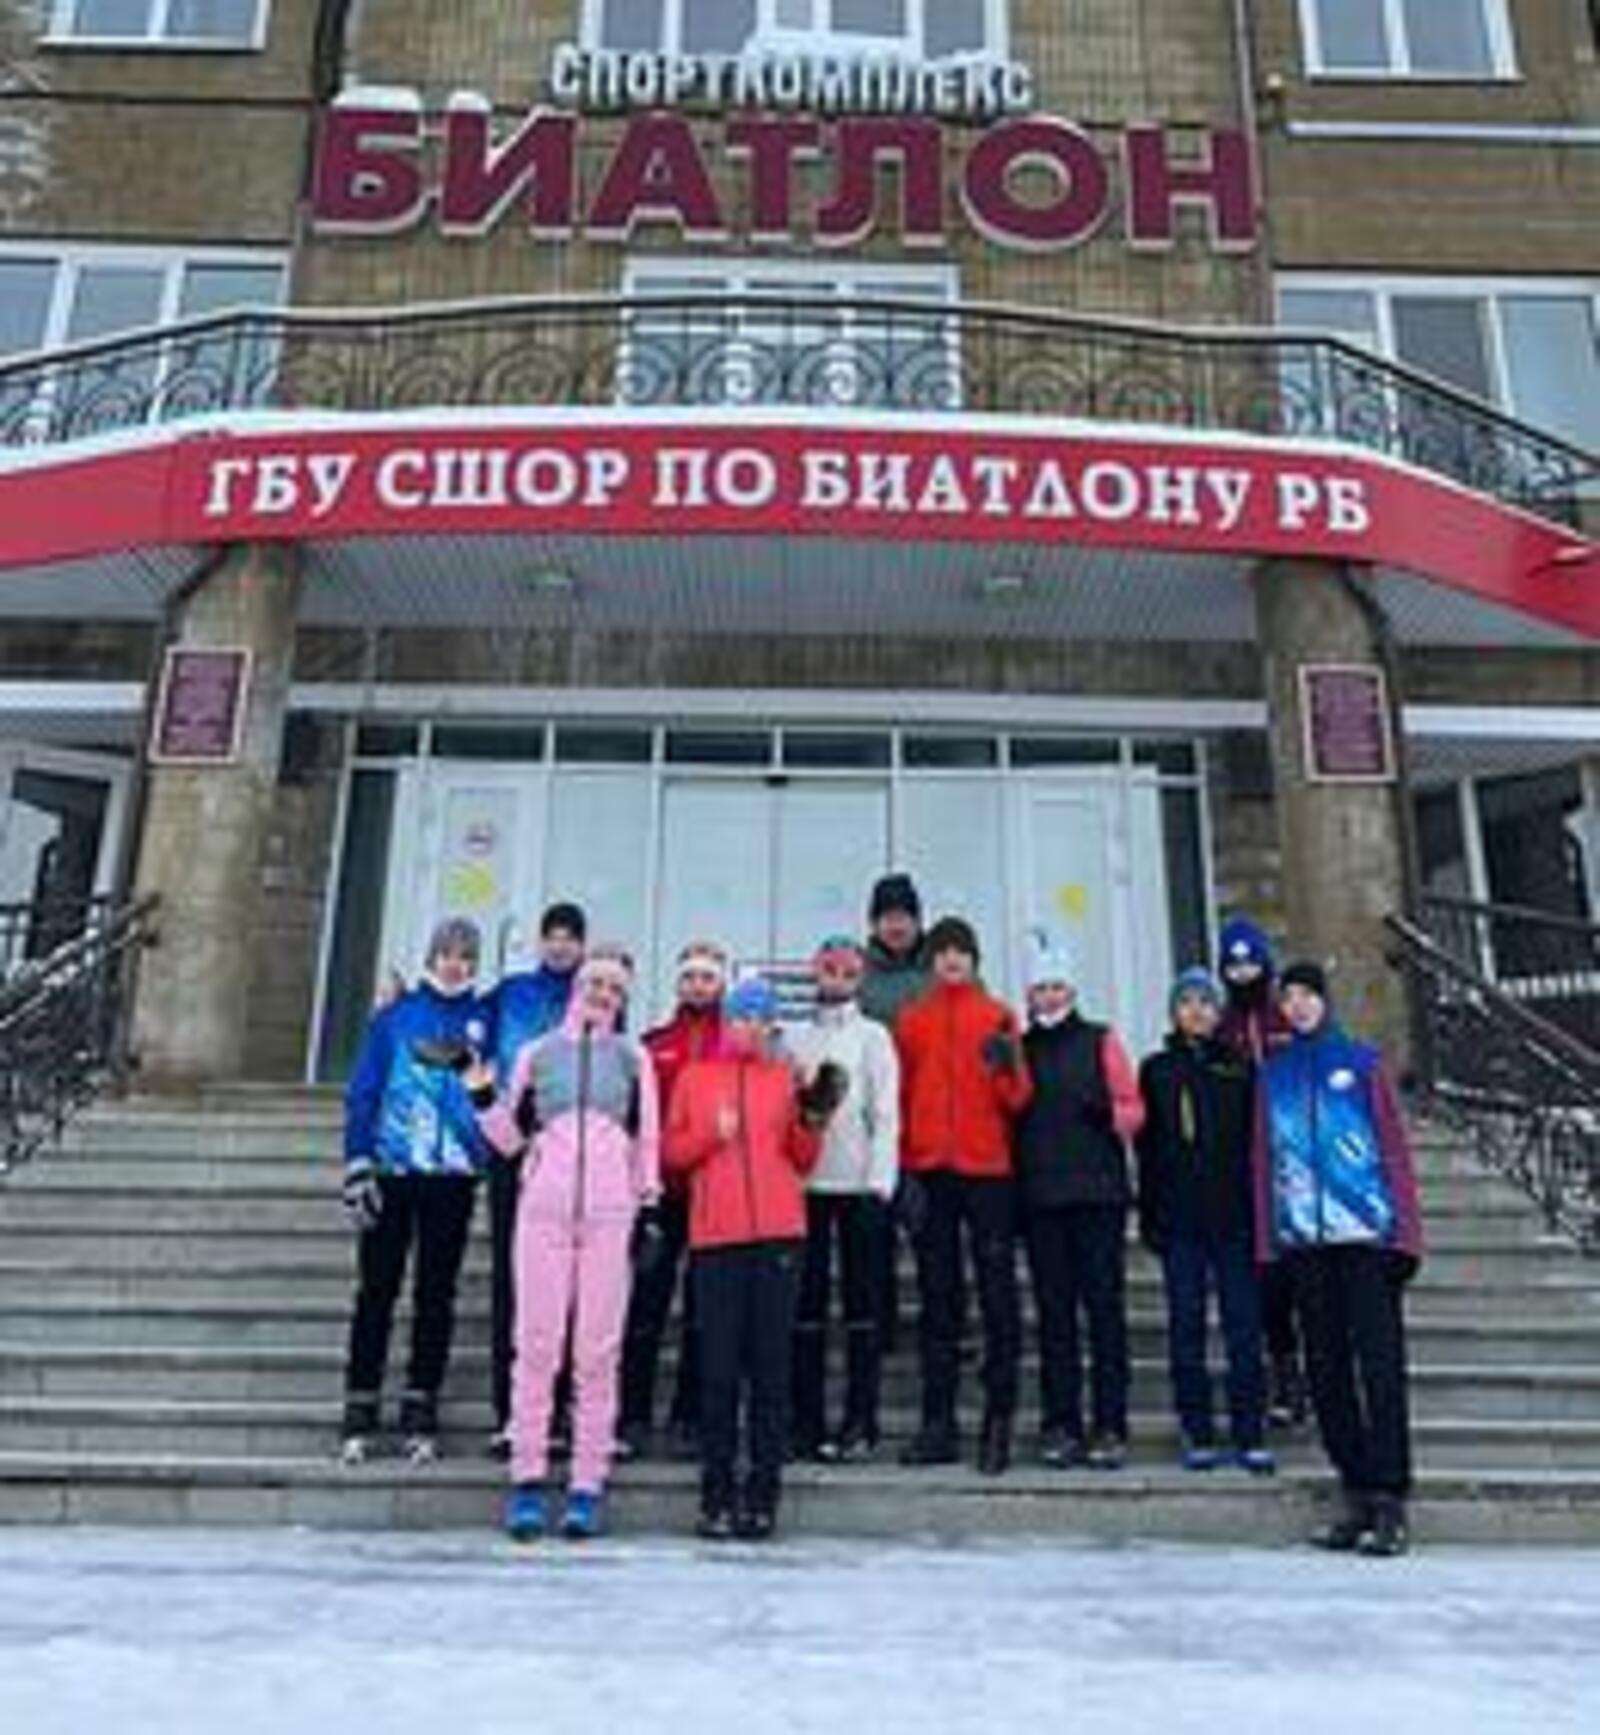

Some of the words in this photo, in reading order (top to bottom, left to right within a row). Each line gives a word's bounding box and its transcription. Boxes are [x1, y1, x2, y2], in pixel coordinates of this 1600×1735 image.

[550, 43, 1034, 114] СПОРТКОМПЛЕКС
[312, 104, 1260, 254] БИАТЛОН
[205, 454, 357, 517] ГБУ
[376, 448, 629, 507] СШОР
[651, 448, 776, 507] ПО
[800, 450, 1252, 529] БИАТЛОНУ
[1277, 474, 1371, 532] РБ
